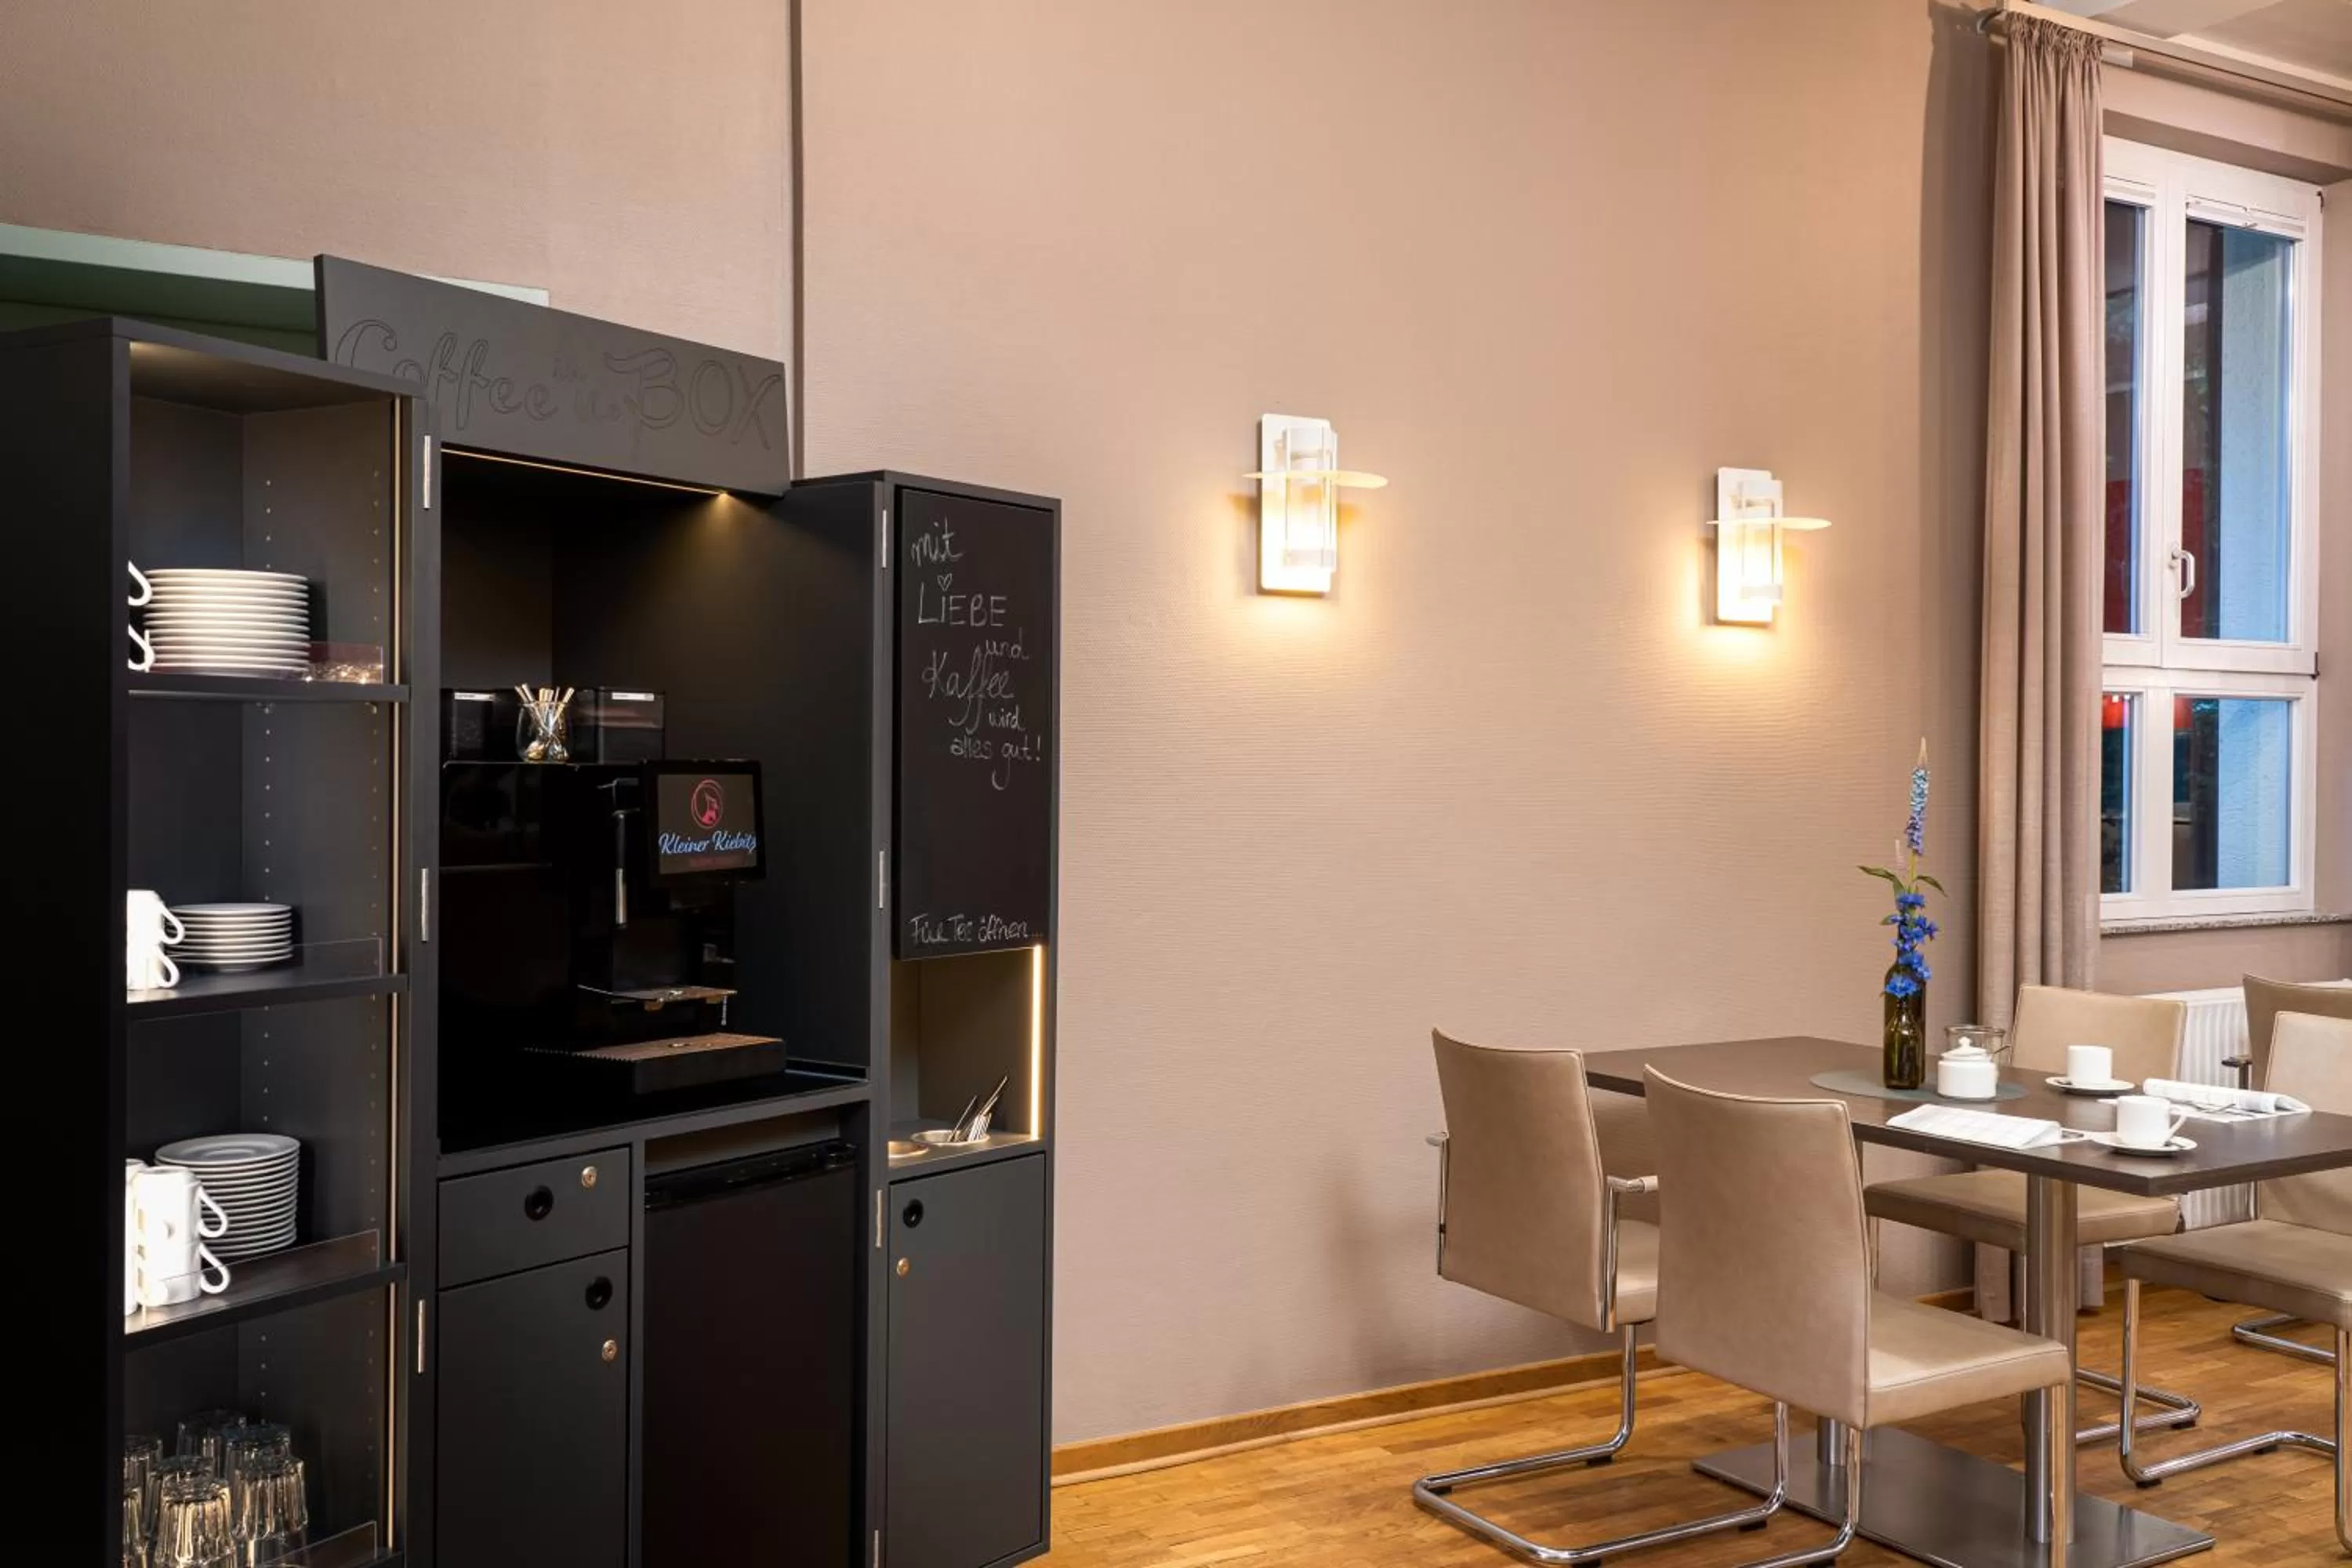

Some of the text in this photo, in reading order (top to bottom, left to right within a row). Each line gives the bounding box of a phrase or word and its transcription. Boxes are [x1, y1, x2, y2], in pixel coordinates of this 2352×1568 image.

[602, 347, 782, 452] BOX
[910, 517, 964, 568] mit
[985, 627, 1029, 660] und
[921, 644, 1014, 735] Kaffee
[988, 705, 1025, 731] wird
[949, 734, 1041, 790] alles gut!
[658, 832, 710, 855] Kleiner
